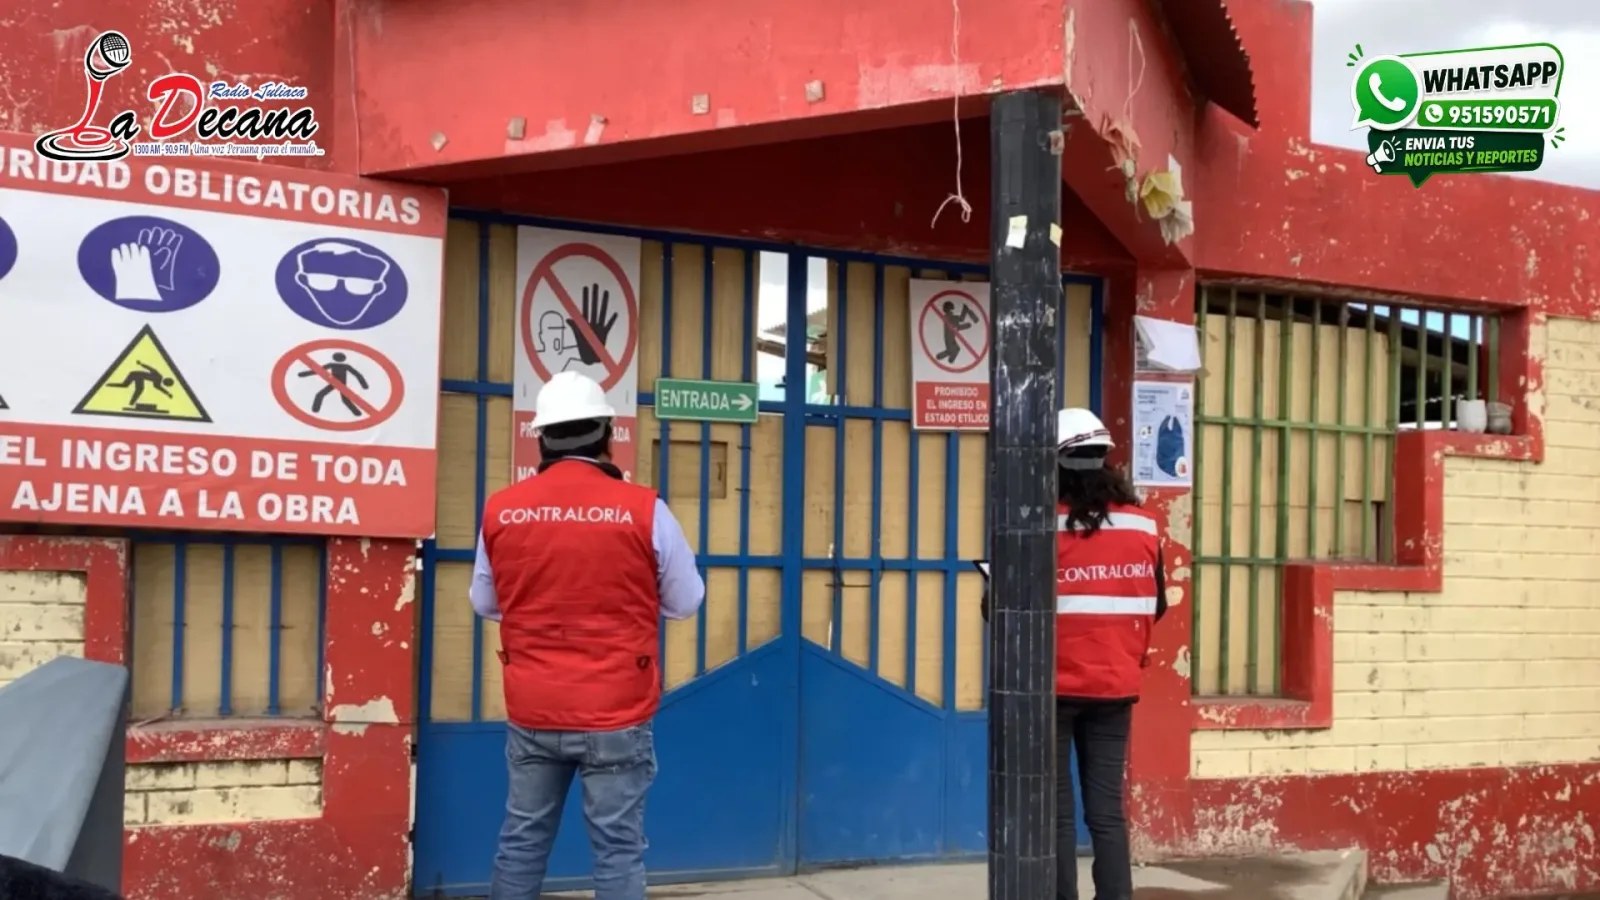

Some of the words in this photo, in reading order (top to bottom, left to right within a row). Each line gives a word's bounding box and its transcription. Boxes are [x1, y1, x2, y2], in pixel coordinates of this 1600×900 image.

[144, 165, 421, 225] OBLIGATORIAS
[661, 388, 730, 411] ENTRADA
[934, 386, 979, 397] PROHIBIDO
[926, 399, 937, 410] EL
[939, 400, 974, 410] INGRESO
[975, 400, 988, 410] EN
[924, 412, 956, 423] ESTADO
[0, 435, 47, 466] EL
[61, 439, 238, 477] INGRESO
[251, 450, 298, 480] DE
[311, 454, 407, 486] TODA
[11, 481, 147, 515] AJENA
[158, 488, 185, 517] A
[198, 490, 245, 519] LA
[257, 493, 360, 525] OBRA
[499, 505, 633, 525] CONTRALORÍA
[1056, 560, 1154, 583] CONTRALORÍA
